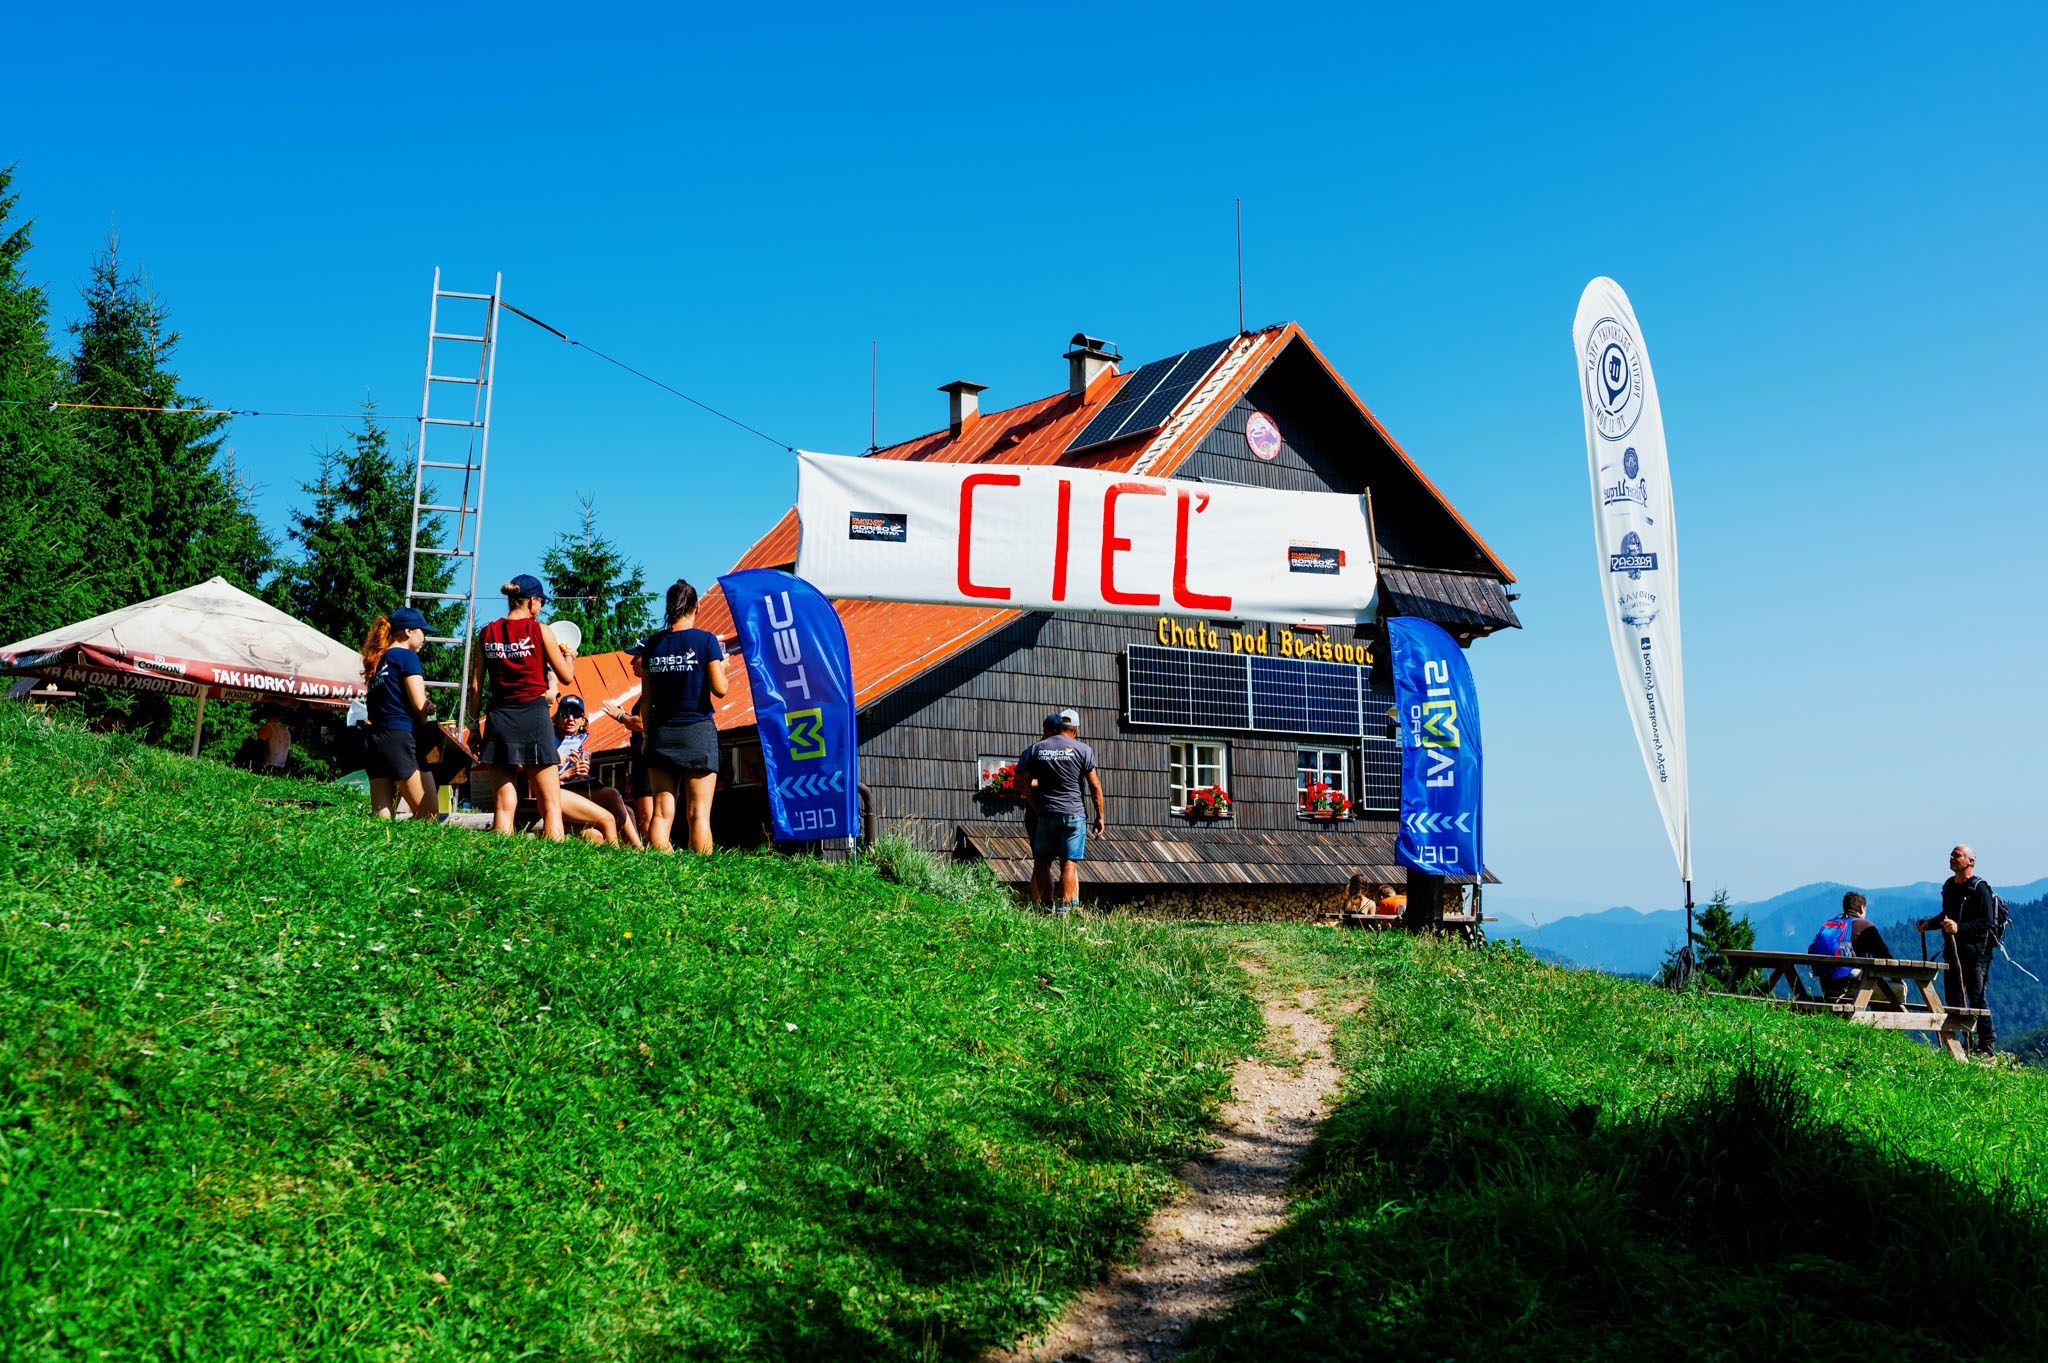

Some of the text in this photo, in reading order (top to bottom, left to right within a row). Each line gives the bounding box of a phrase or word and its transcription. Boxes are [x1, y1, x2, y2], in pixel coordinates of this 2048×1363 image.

[1158, 616, 1219, 650] Chata
[1230, 628, 1267, 655] pod
[211, 668, 242, 687] TAK
[243, 674, 297, 695] HORKÝ,
[300, 682, 330, 697] AKO
[332, 684, 353, 701] MÁ
